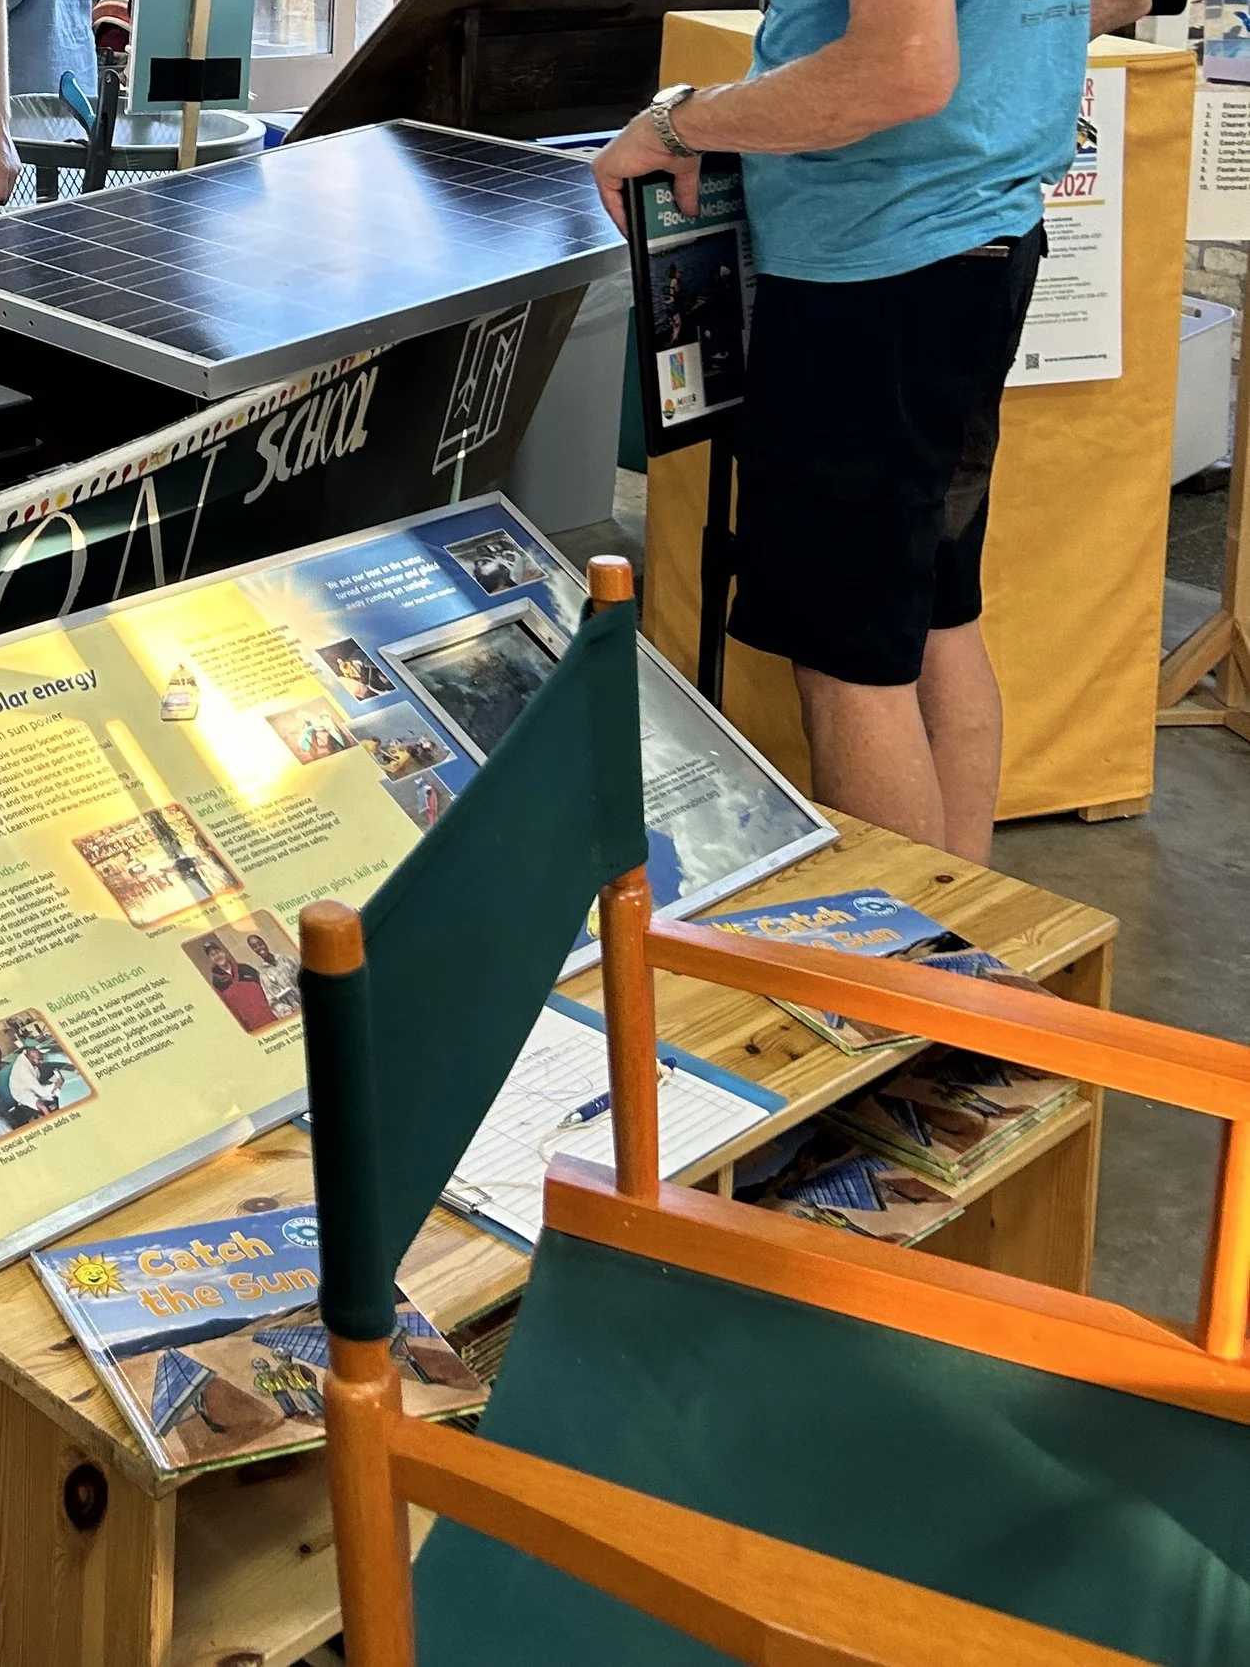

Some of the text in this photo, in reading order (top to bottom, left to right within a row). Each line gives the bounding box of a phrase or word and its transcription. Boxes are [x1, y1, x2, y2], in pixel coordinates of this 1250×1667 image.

[1052, 173, 1097, 197] 2027
[245, 365, 379, 504] SCHOOL
[338, 576, 353, 587] put
[351, 572, 365, 583] our
[363, 567, 383, 578] boat
[379, 565, 391, 573] in
[388, 561, 403, 571] the
[32, 669, 96, 699] energy
[6, 724, 29, 737] sun
[28, 711, 63, 731] power
[9, 742, 36, 755] Energy
[35, 733, 63, 746] Society
[20, 770, 62, 789] Experience
[2, 802, 44, 821] something
[43, 792, 70, 805] useful,
[4, 795, 20, 808] and
[19, 793, 34, 802] the
[34, 785, 55, 798] pride
[185, 789, 218, 806] Racing
[5, 820, 29, 833] Learn
[28, 813, 50, 824] more
[37, 870, 56, 881] boat
[273, 857, 388, 913] Winners gain glory, skill and
[5, 897, 16, 905] to
[14, 890, 34, 902] learn
[33, 882, 56, 895] about
[15, 894, 56, 914] technology,
[54, 886, 70, 898] hull
[4, 934, 14, 942] is
[12, 931, 23, 939] to
[22, 919, 53, 936] engineer
[52, 916, 60, 924] a
[7, 912, 40, 929] materials
[39, 902, 68, 917] science.
[757, 906, 856, 935] Catch
[17, 924, 66, 949] solar-powered
[66, 917, 84, 930] craft
[82, 912, 98, 923] that
[33, 944, 50, 955] fast
[48, 937, 64, 949] and
[63, 932, 83, 944] agile.
[46, 965, 145, 1013] Building is hands-on
[58, 1020, 69, 1028] In
[66, 1007, 98, 1024] building
[103, 982, 151, 1009] solar-powered
[148, 977, 170, 989] boat,
[65, 991, 164, 1038] teams learn how to use tools
[73, 1001, 166, 1048] and materials with skill and
[79, 1003, 194, 1058] imagination. rate teams on
[86, 1014, 194, 1068] their level of craftsmanship and
[94, 1039, 174, 1080] project documentation.
[0, 1136, 24, 1152] special
[24, 1129, 42, 1143] paint
[40, 1123, 53, 1136] job
[53, 1116, 70, 1128] adds
[68, 1111, 81, 1121] the
[14, 1143, 38, 1158] touch.
[139, 1230, 274, 1276] Catch
[140, 1266, 318, 1318] the Sun
